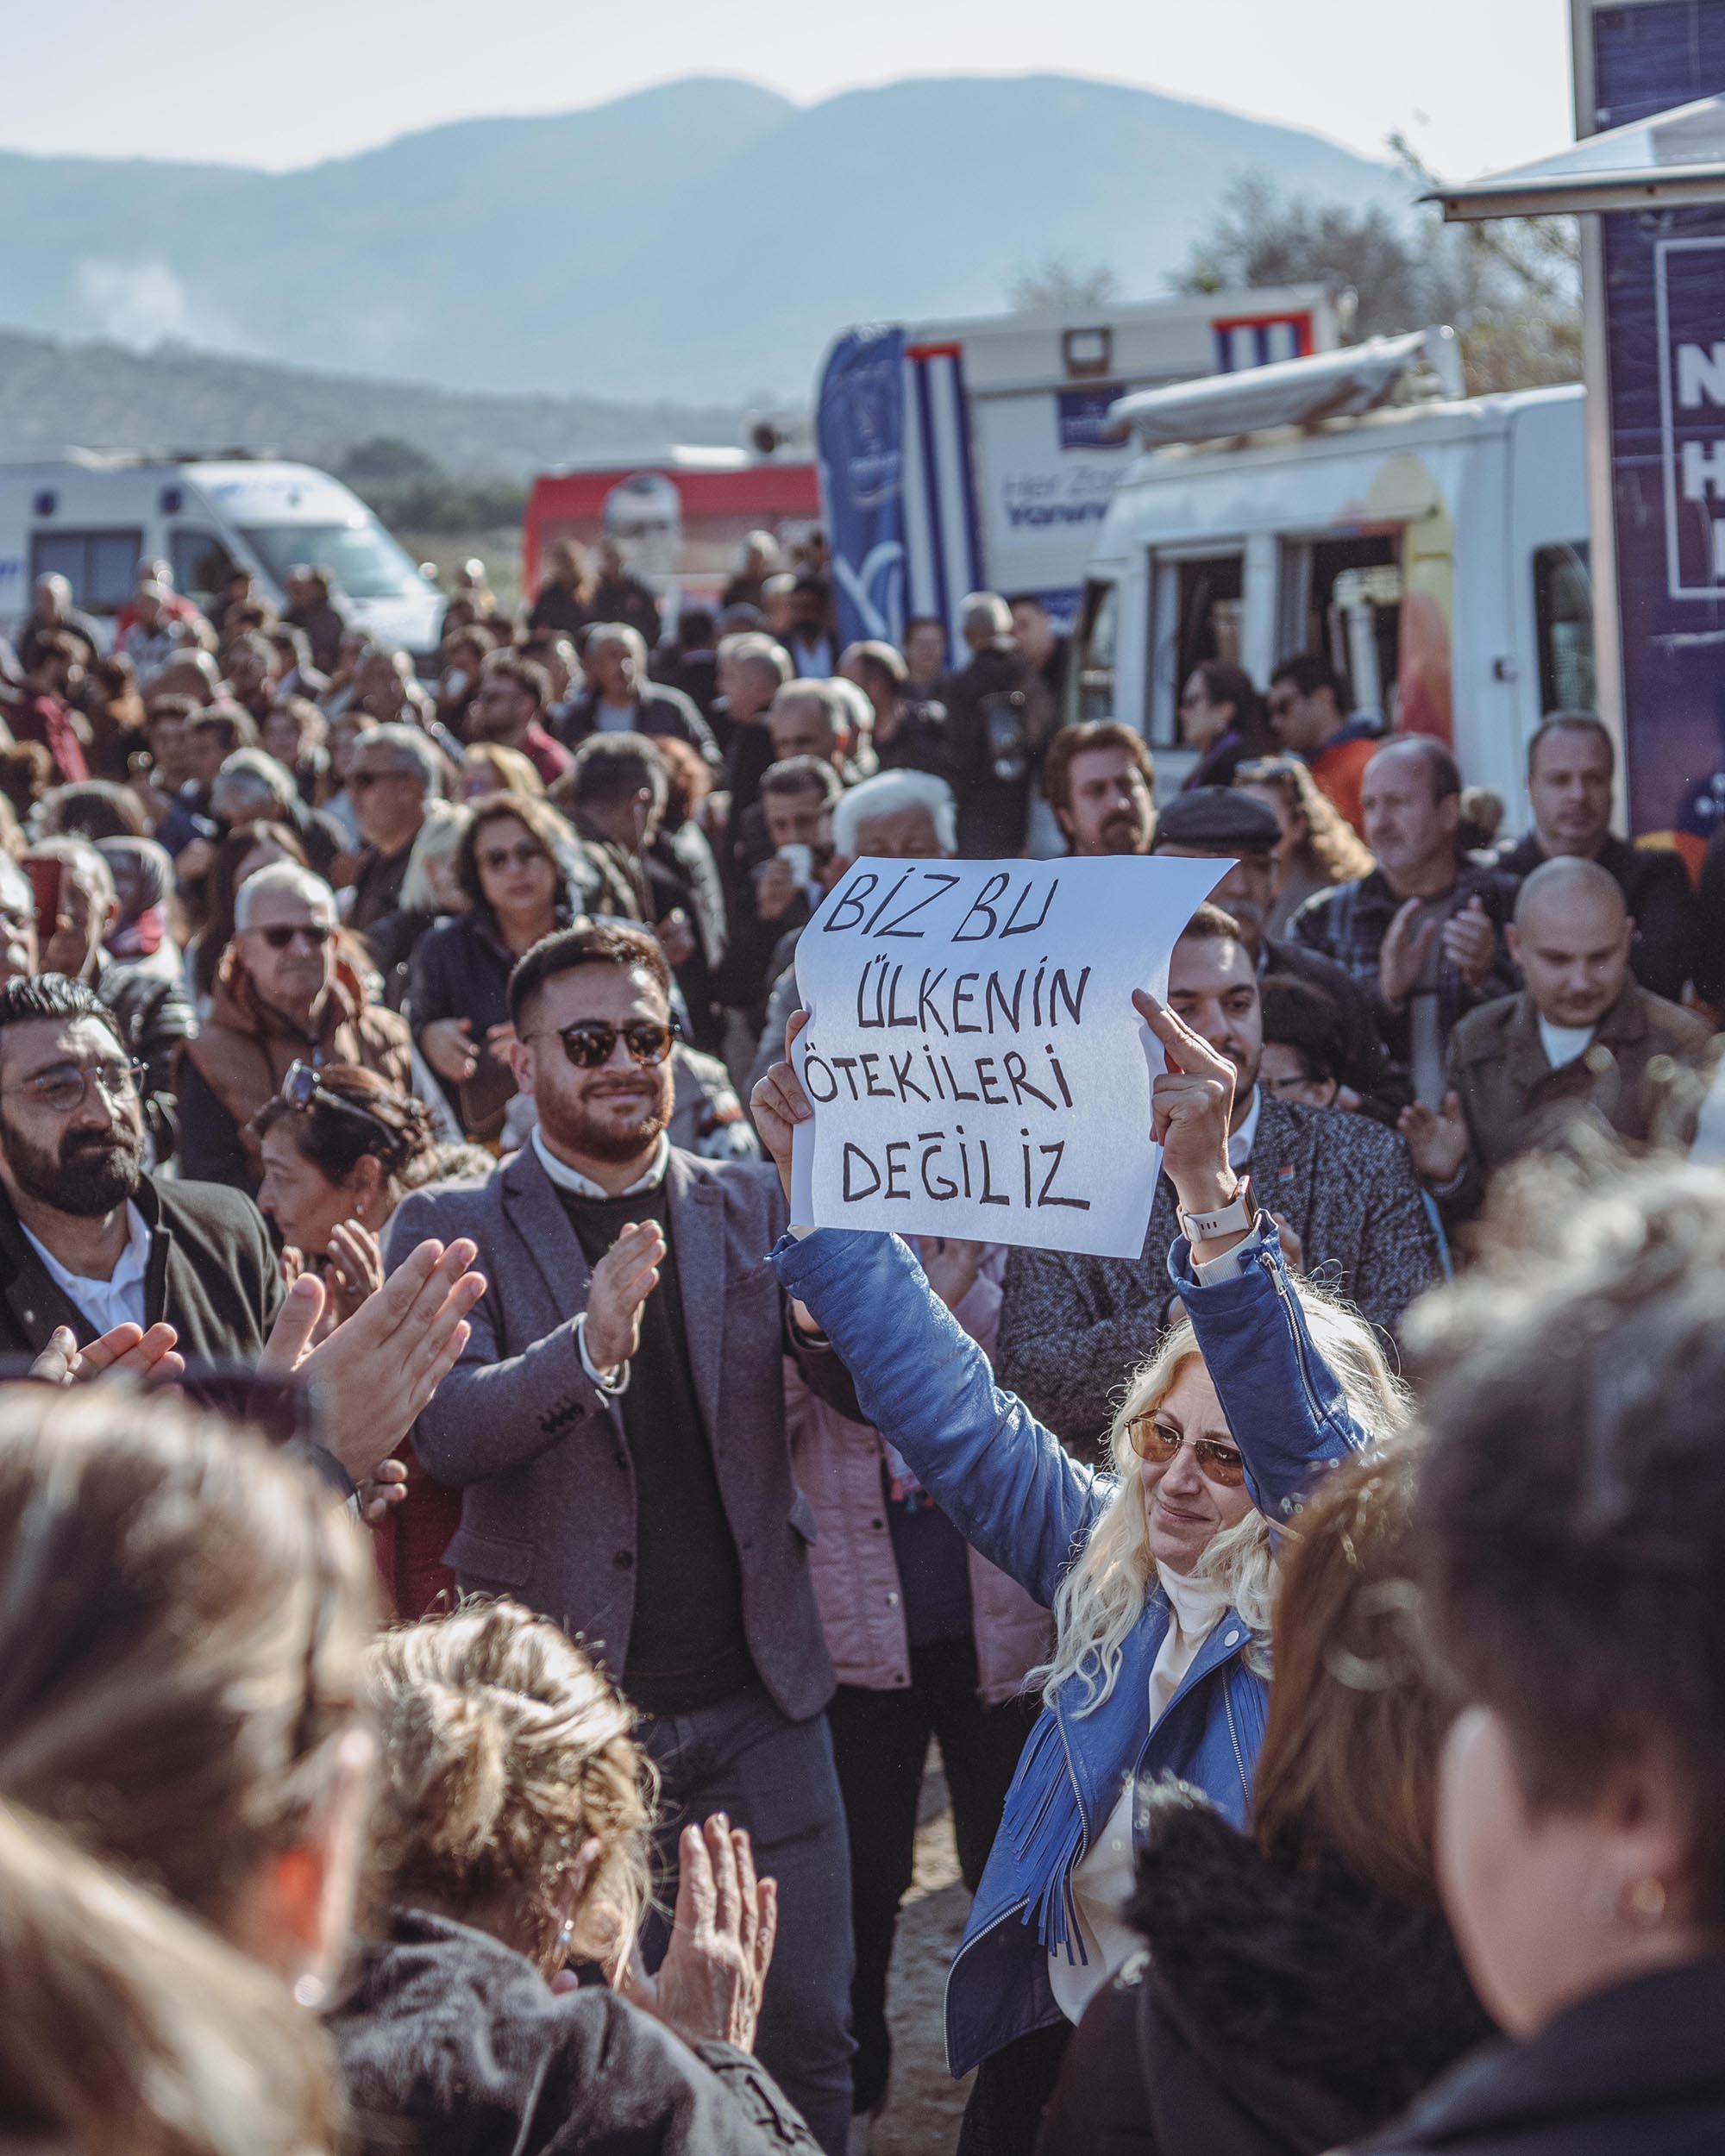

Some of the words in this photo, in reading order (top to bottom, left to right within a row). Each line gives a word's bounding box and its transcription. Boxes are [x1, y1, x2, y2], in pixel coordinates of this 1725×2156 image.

[823, 867, 960, 937] BİZ
[950, 872, 1059, 943] BU
[856, 954, 1091, 1037] ÜLKENİN
[804, 1042, 1074, 1112] ÖTEKİLERİ
[843, 1125, 1091, 1211] DEĞİLİZ
